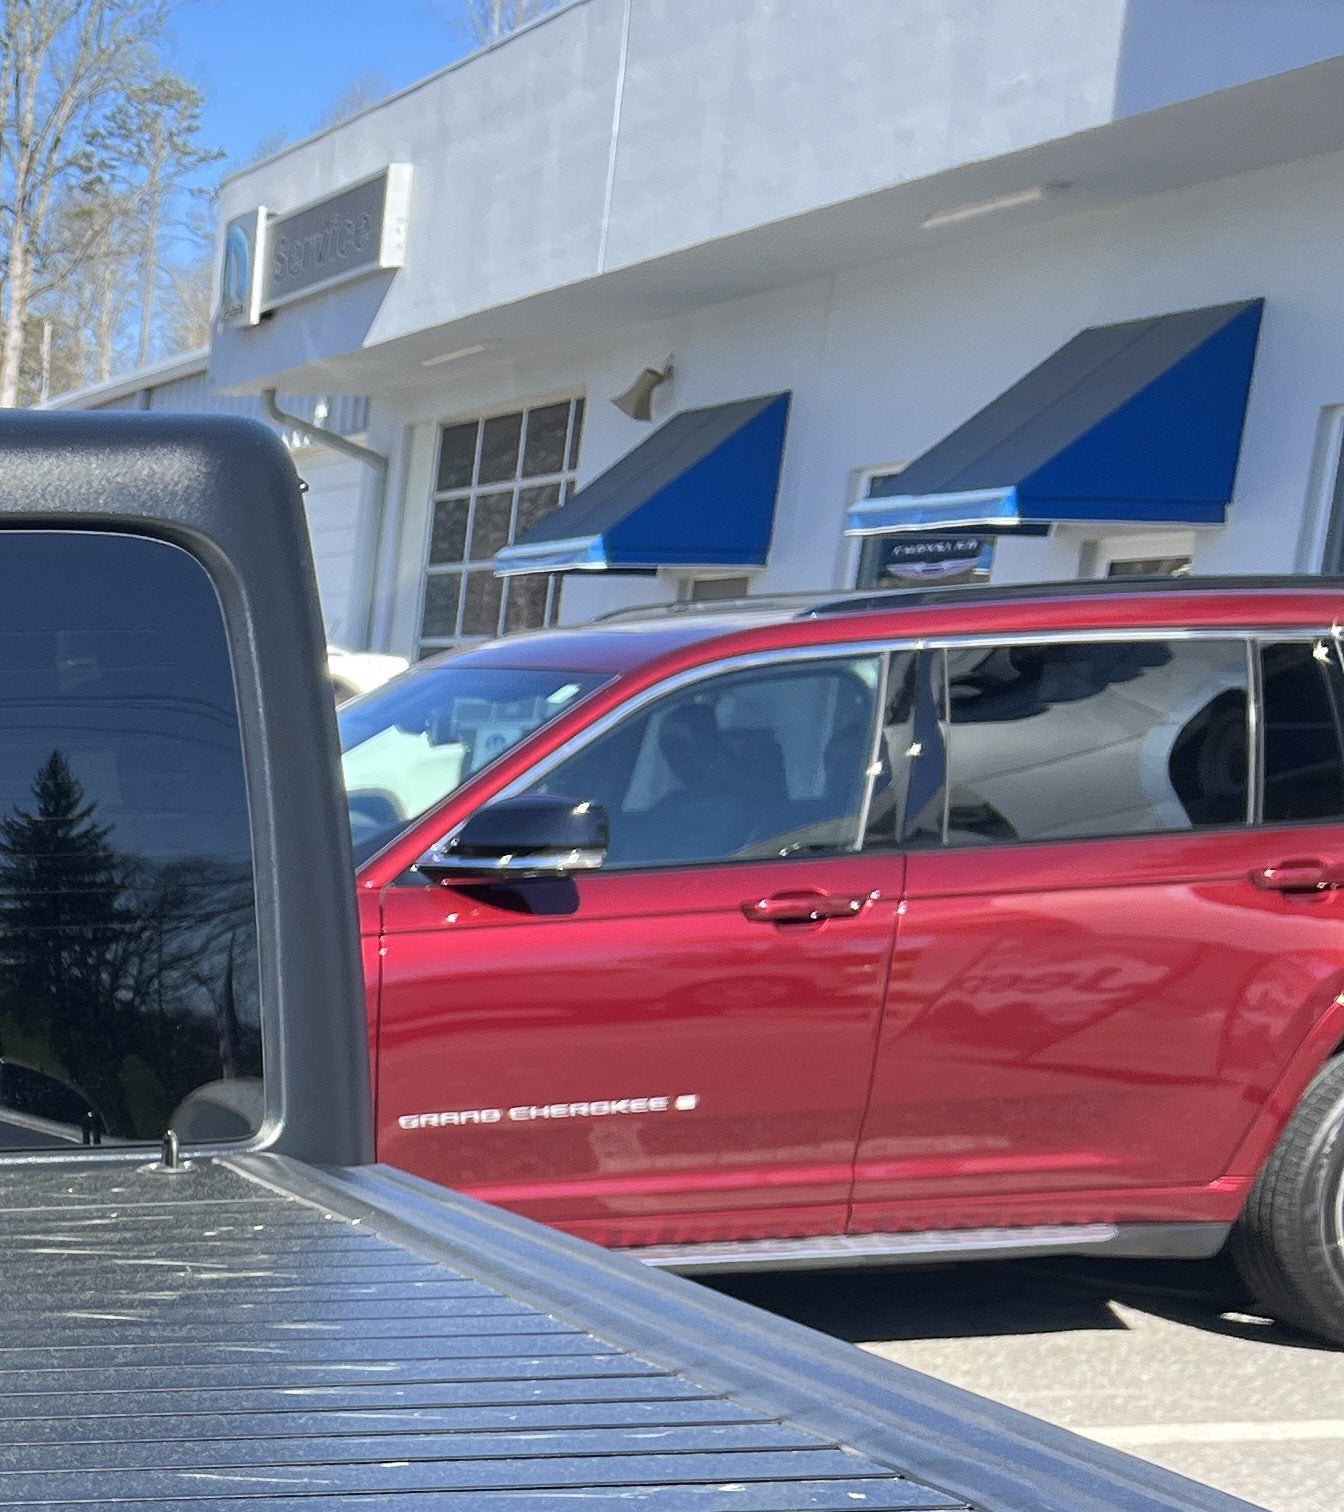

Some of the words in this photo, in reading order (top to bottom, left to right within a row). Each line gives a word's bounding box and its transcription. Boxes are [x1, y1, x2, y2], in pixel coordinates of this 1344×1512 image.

[273, 212, 372, 282] Service
[398, 1108, 502, 1129] GRAND
[508, 1095, 670, 1121] CHEROKEE
